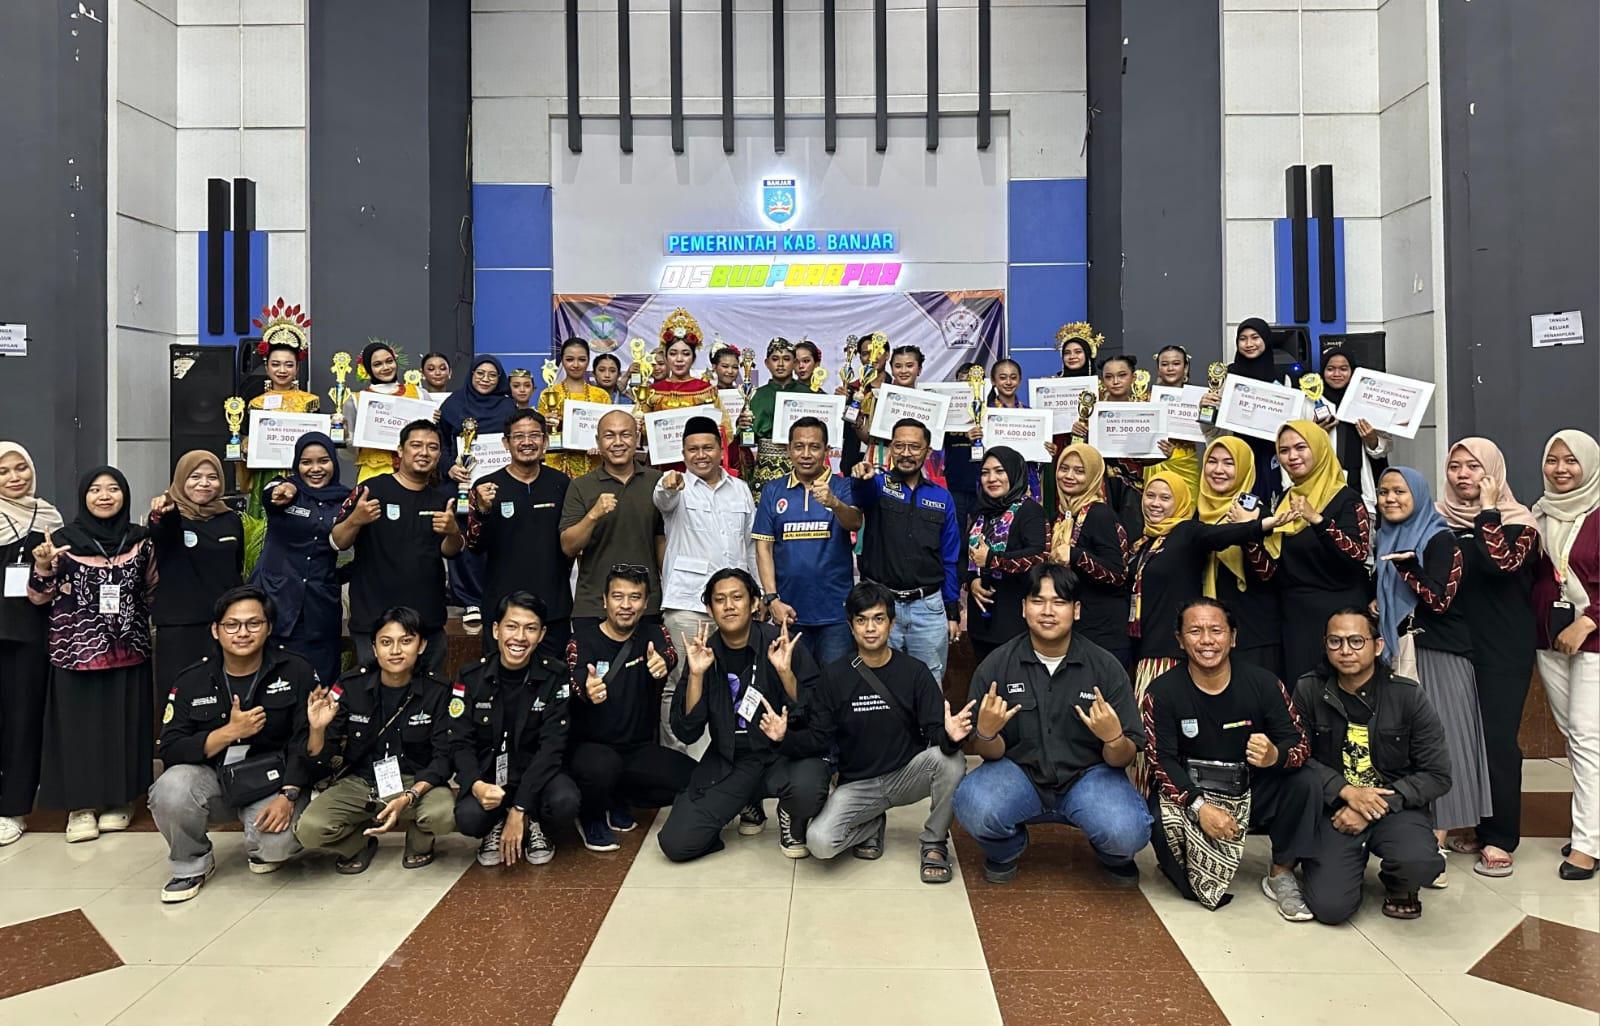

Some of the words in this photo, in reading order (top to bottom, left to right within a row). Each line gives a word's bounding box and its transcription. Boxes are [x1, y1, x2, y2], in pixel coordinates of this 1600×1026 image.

[668, 234, 777, 253] PEMERINTAH
[783, 233, 821, 250] KAB.
[828, 232, 894, 250] BANJAR
[783, 521, 829, 533] MANIS
